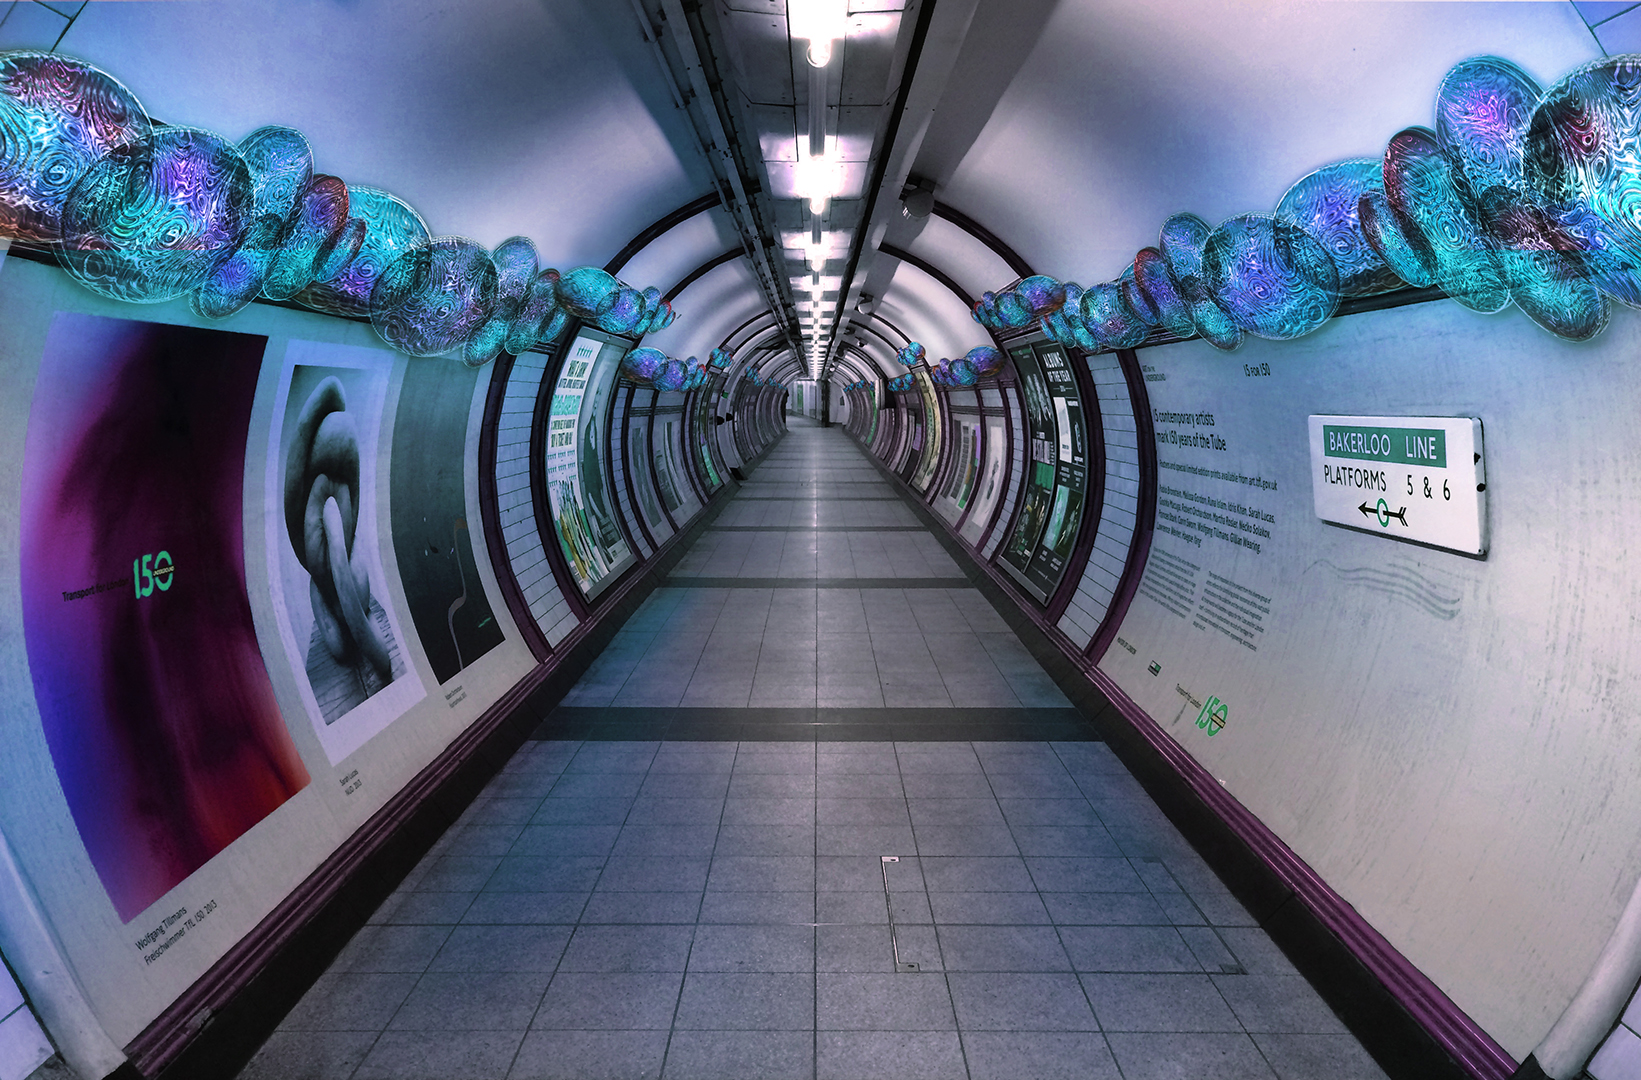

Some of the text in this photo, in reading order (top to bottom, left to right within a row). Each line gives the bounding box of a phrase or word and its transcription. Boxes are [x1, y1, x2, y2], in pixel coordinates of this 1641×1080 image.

[1042, 351, 1064, 369] ALBUMS
[1243, 362, 1271, 377] 15 FOR 150
[1159, 411, 1195, 428] contemporary
[1195, 410, 1215, 426] artists
[1156, 429, 1227, 451] mark 150 years of the Tube
[1329, 432, 1438, 460] BAKERLOO LINE
[1324, 465, 1451, 501] PLATFORMS 5 & 6
[1248, 506, 1260, 520] Sarah
[1261, 509, 1275, 524] Lucas,
[1243, 536, 1261, 555] Wearing,
[133, 550, 174, 599] 150
[62, 577, 129, 602] Transport for London
[1195, 695, 1229, 737] 150
[135, 906, 188, 951] Wolfgang Tillmans
[144, 899, 218, 966] Freischwimmer TfL 150 2013
